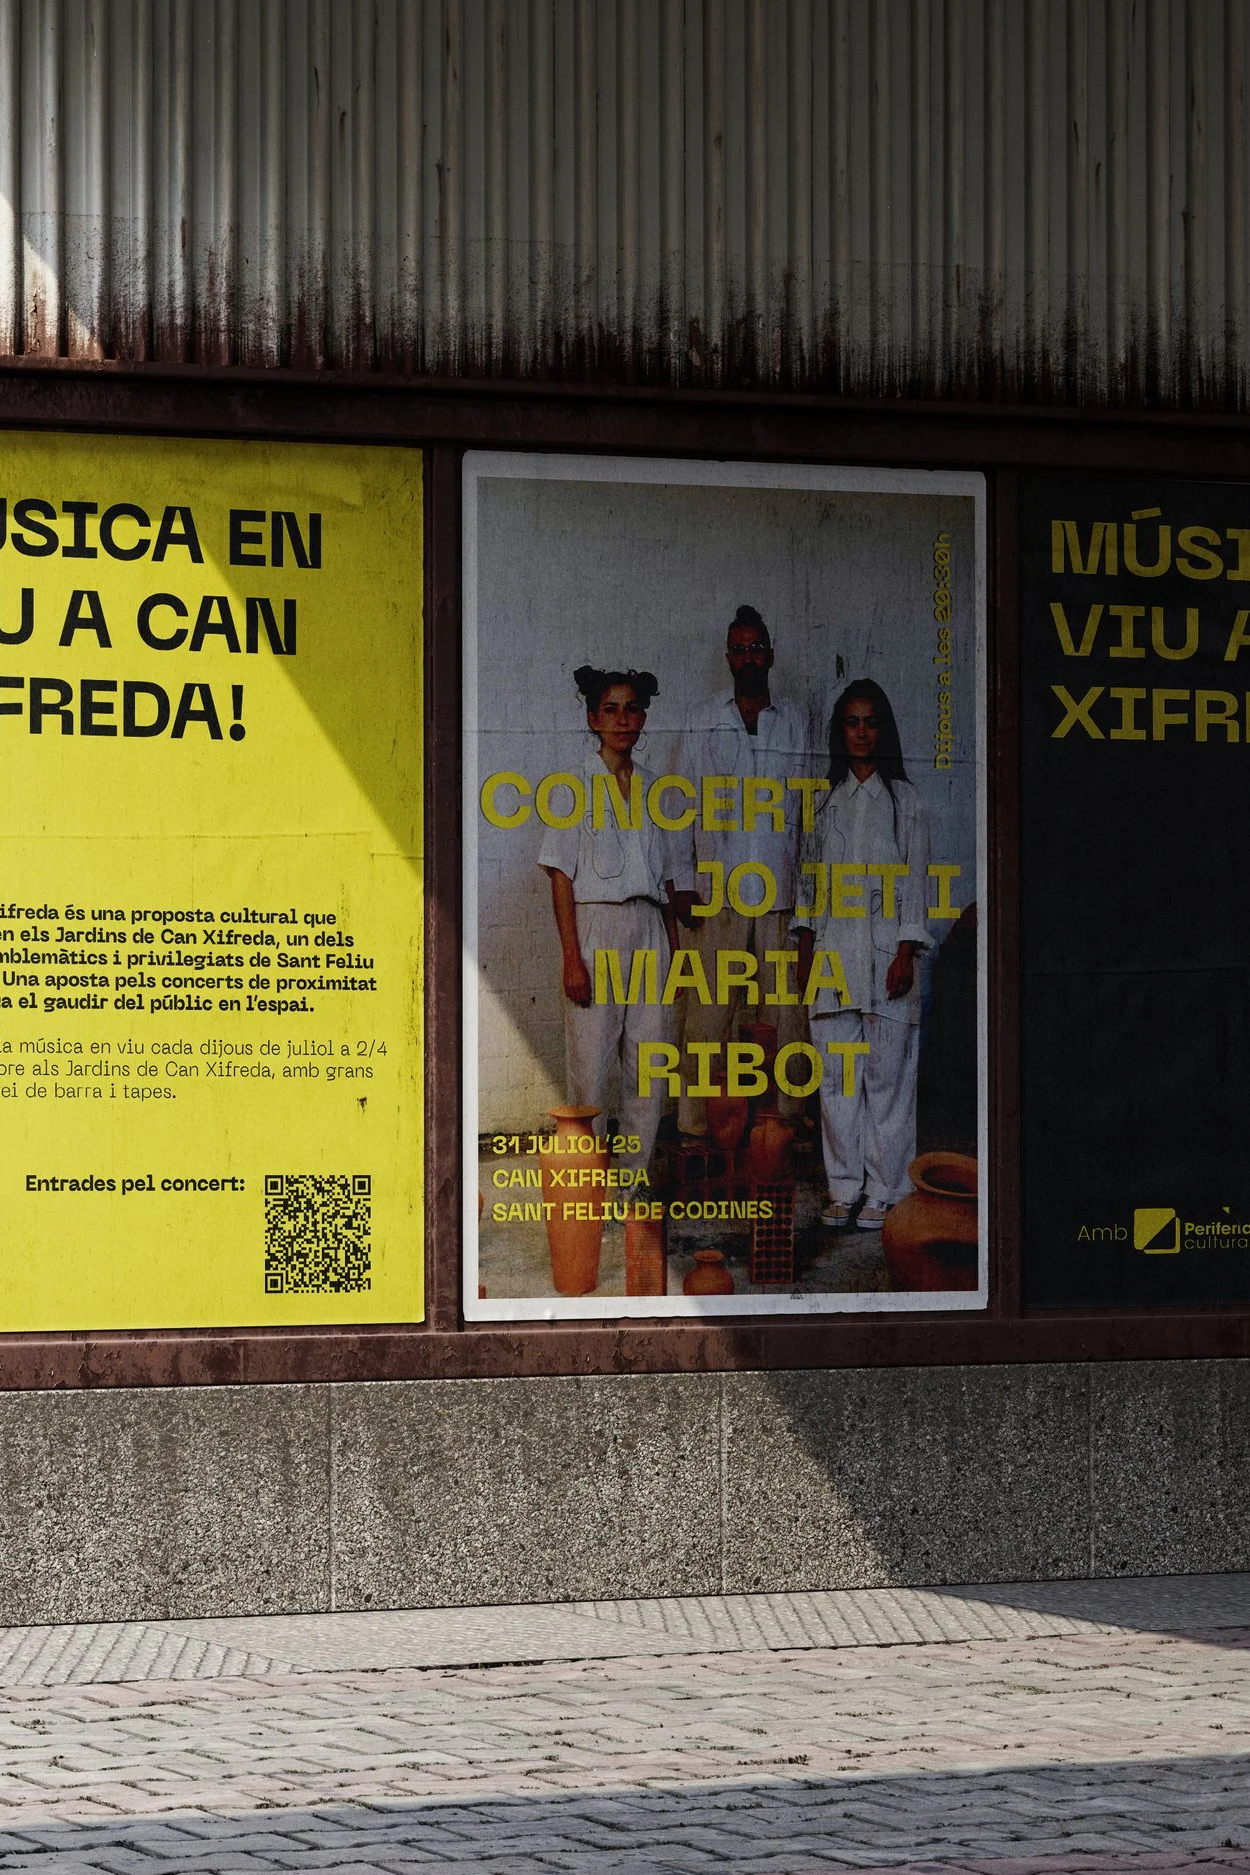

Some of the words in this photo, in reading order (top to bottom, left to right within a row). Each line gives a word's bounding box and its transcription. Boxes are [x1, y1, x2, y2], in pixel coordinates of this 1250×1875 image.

[229, 509, 322, 569] EN
[59, 590, 112, 648] A
[136, 593, 297, 656] CAN
[1050, 602, 1199, 660] VIU
[933, 627, 951, 665] les
[938, 671, 951, 686] a
[1051, 685, 1250, 743] XIFR
[934, 691, 954, 769] Dijous
[480, 772, 831, 833] CONCERT
[690, 861, 777, 919] JO
[796, 863, 909, 919] JET
[928, 864, 961, 919] I
[64, 904, 85, 921] és
[91, 909, 126, 921] una
[131, 908, 214, 925] proposta
[220, 908, 298, 924] cultural
[303, 912, 337, 927] que
[20, 926, 50, 942] els
[55, 927, 126, 943] Jardins
[132, 929, 154, 944] de
[161, 930, 197, 945] Can
[203, 929, 280, 949] Xifreda,
[286, 934, 309, 946] un
[314, 931, 354, 947] dels
[113, 950, 122, 965] i
[127, 950, 244, 970] privilegiats
[249, 952, 271, 967] de
[277, 953, 320, 968] Sant
[325, 953, 374, 969] Feliu
[3, 971, 39, 987] Una
[45, 973, 109, 990] aposta
[115, 972, 156, 991] pels
[162, 976, 243, 989] concerts
[248, 974, 270, 989] de
[276, 976, 377, 992] proximitat
[594, 949, 852, 1006] MARIA
[18, 992, 38, 1009] el
[44, 994, 108, 1013] gaudir
[114, 994, 145, 1010] del
[150, 994, 212, 1013] públic
[219, 999, 240, 1011] en
[246, 995, 314, 1015] l'espai.
[20, 1038, 83, 1054] música
[90, 1042, 111, 1054] en
[117, 1038, 144, 1055] viu
[151, 1039, 193, 1055] cada
[200, 1039, 253, 1058] dijous
[260, 1040, 281, 1056] de
[286, 1040, 334, 1058] juliol
[340, 1045, 350, 1056] a
[356, 1039, 387, 1058] 2/4
[32, 1059, 59, 1076] als
[65, 1060, 130, 1076] Jardins
[137, 1061, 158, 1077] de
[165, 1061, 199, 1077] Can
[206, 1061, 275, 1080] Xifreda,
[282, 1062, 319, 1078] amb
[325, 1066, 373, 1081] grans
[637, 1041, 871, 1099] RIBOT
[26, 1082, 47, 1098] de
[55, 1083, 102, 1099] barra
[110, 1083, 116, 1098] i
[123, 1084, 176, 1101] tapes.
[492, 1136, 520, 1155] 31
[26, 1174, 116, 1192] Entrades
[122, 1174, 155, 1196] pel
[161, 1175, 245, 1192] concert:
[492, 1169, 542, 1188] CAN
[550, 1168, 650, 1187] XIFREDA
[492, 1202, 555, 1222] SANT
[563, 1202, 628, 1220] FELIU
[635, 1201, 663, 1220] DE
[669, 1200, 773, 1219] CODINES
[1077, 1224, 1127, 1241] Amb
